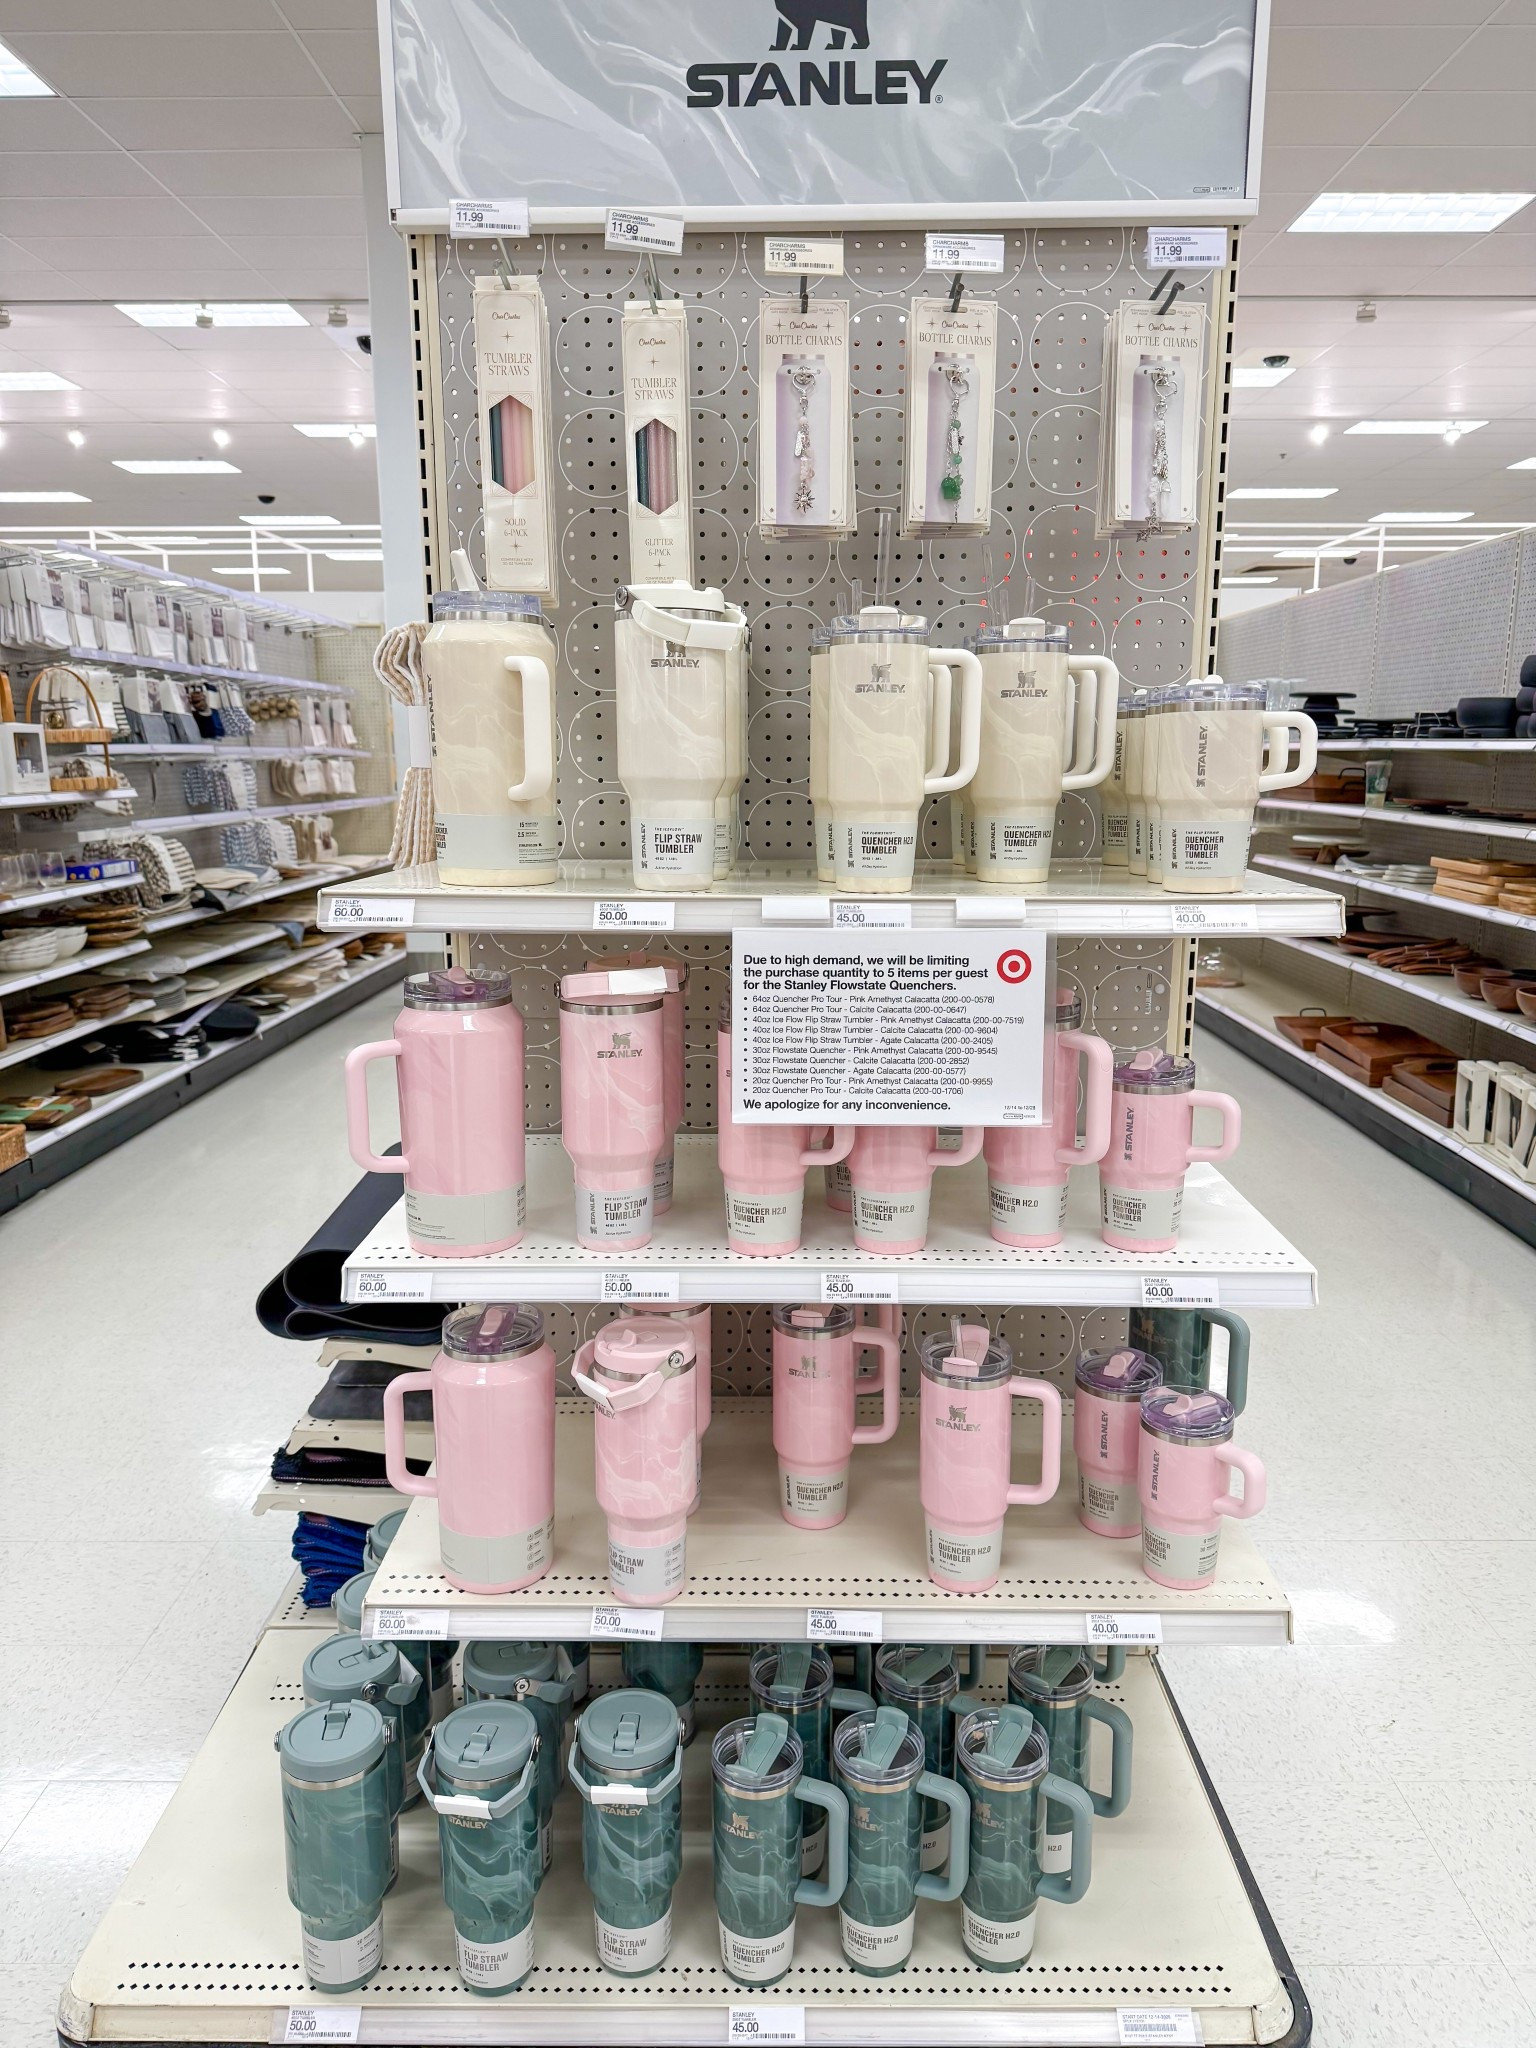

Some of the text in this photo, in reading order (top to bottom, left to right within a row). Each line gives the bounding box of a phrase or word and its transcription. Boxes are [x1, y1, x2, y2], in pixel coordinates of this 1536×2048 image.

[686, 59, 948, 108] STANLEY
[456, 212, 484, 222] 11.99
[611, 222, 639, 235] 11.99
[933, 250, 960, 259] 11.99
[1155, 246, 1182, 256] 11.99
[770, 252, 797, 262] 11.99
[765, 334, 843, 346] BOTTLE CHARMS
[919, 332, 992, 346] BOTTLE CHARMS
[1125, 335, 1198, 348] BOTTLE CHARMS
[484, 352, 532, 364] TUMBLER
[488, 365, 530, 376] STRAWS
[630, 377, 678, 388] TUMBLER
[634, 390, 674, 400] STRAWS
[504, 518, 526, 526] SOLID
[504, 529, 528, 537] 6-PACK
[645, 538, 674, 546] GLITTER
[648, 548, 672, 556] 6-PACK
[650, 659, 699, 668] STANLEY
[855, 684, 905, 693] STANLEY
[1000, 690, 1048, 698] STANLEY
[1115, 731, 1123, 772] STANLEY
[1198, 725, 1208, 777] STANLEY
[654, 834, 702, 844] FLIP STRAW
[1004, 830, 1042, 839] QUENCHER
[862, 836, 902, 846] QUENCHER
[1004, 838, 1038, 847] TUMBLER
[1185, 836, 1224, 844] QUENCHER
[654, 844, 694, 854] TUMBLER
[862, 846, 897, 854] TUMBLER
[1185, 851, 1218, 859] TUMBLER
[334, 907, 364, 916] 60.00
[598, 911, 628, 920] 50.00
[836, 914, 866, 922] 45.00
[1176, 914, 1206, 923] 40.00
[744, 955, 767, 964] Due
[770, 955, 781, 964] to
[785, 955, 809, 966] high
[813, 955, 864, 967] demand,
[887, 955, 906, 965] will
[910, 956, 923, 965] be
[928, 956, 969, 967] limiting
[743, 968, 988, 979] the purchase quantity to 5 items per guest
[743, 980, 956, 992] for the Stanley Flowstate Quenchers.
[868, 996, 902, 1004] Amethyst
[805, 1016, 818, 1024] Flip
[899, 1017, 933, 1025] Amethyst
[596, 1049, 642, 1058] STANLEY
[743, 1099, 950, 1111] We apologize for any inconvenience.
[1125, 1106, 1134, 1151] STANLEY
[604, 1198, 648, 1212] FLIP STRAW
[860, 1202, 914, 1214] QUENCHER H2.0
[1112, 1198, 1146, 1210] QUENCHER
[604, 1209, 642, 1221] TUMBLER
[733, 1204, 786, 1216] QUENCHER H2.0
[1112, 1206, 1142, 1216] PROTOUR
[734, 1212, 765, 1224] TUMBLER
[861, 1210, 893, 1222] TUMBLER
[1112, 1212, 1142, 1222] TUMBLER
[359, 1282, 386, 1292] 60.00
[605, 1282, 632, 1292] 50.00
[826, 1283, 854, 1292] 45.00
[1145, 1287, 1173, 1297] 40.00
[936, 1418, 981, 1432] STANLEY
[1100, 1411, 1109, 1451] STANLEY
[1152, 1450, 1160, 1492] STANLEY
[796, 1485, 832, 1495] QUENCHER
[796, 1492, 828, 1500] TUMBLER
[938, 1542, 991, 1556] QUENCHER H2.0
[938, 1550, 970, 1563] TUMBLER
[379, 1618, 406, 1628] 60.00
[594, 1616, 621, 1626] 50.00
[810, 1620, 836, 1629] 45.00
[1092, 1624, 1118, 1634] 40.00
[923, 1841, 936, 1850] H2.0
[1048, 1844, 1062, 1852] H2.0
[846, 1925, 899, 1944] QUENCHER H2.0
[1006, 1930, 1020, 1940] H2.0
[604, 1933, 647, 1948] FLIP STRAW
[847, 1934, 878, 1951] TUMBLER
[604, 1942, 638, 1956] TUMBLER
[732, 1942, 785, 1957] QUENCHER H2.0
[464, 1950, 509, 1964] FLIP STRAW
[732, 1951, 766, 1964] TUMBLER
[464, 1958, 500, 1972] TUMBLER
[289, 2021, 316, 2031] 50.00
[732, 2022, 759, 2032] 45.00
